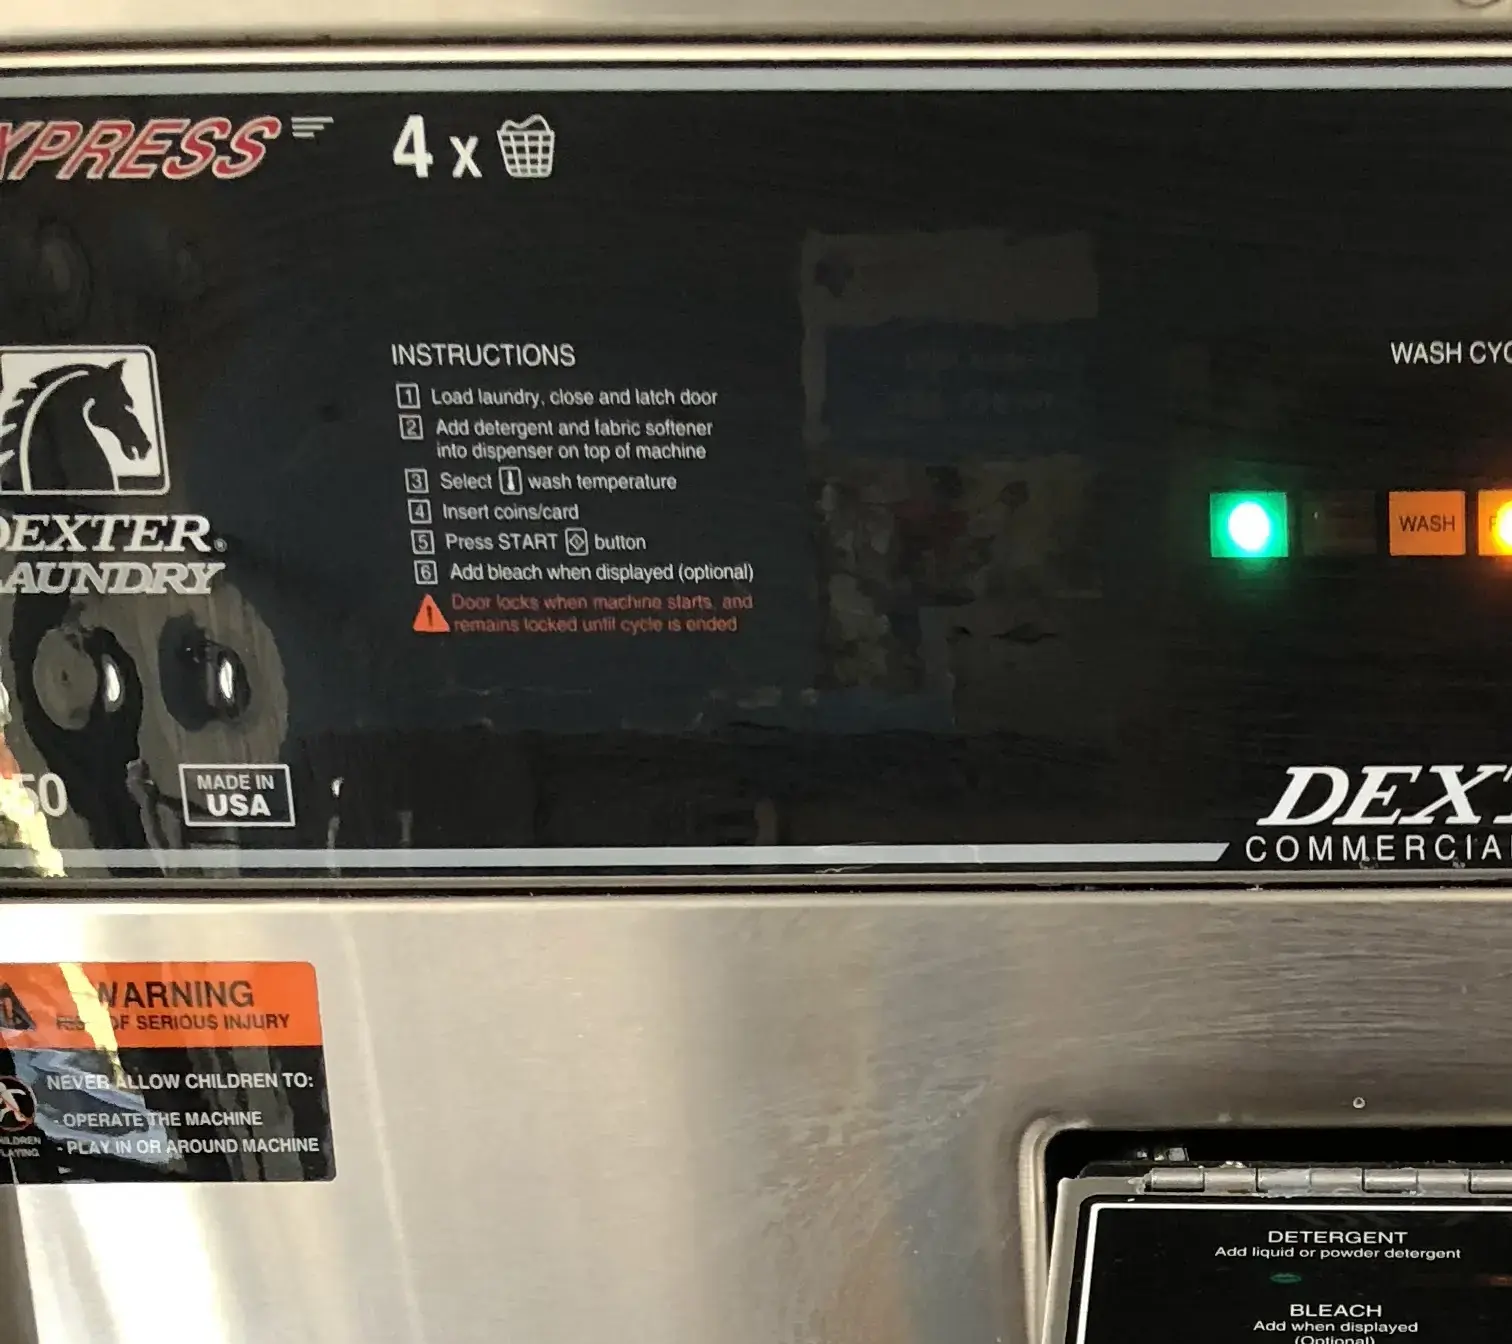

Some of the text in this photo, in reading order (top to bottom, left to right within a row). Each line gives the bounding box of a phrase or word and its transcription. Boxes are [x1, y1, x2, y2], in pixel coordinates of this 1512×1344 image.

[392, 114, 432, 179] 4
[392, 343, 576, 367] INSTRUCTIONS
[1391, 342, 1462, 365] WASH
[431, 388, 718, 409] Load laundry, close and latch door
[436, 420, 712, 439] Add detergent and fabric softener
[437, 443, 706, 463] into dispenser on top of machine
[440, 474, 677, 492] Select wash temperature
[443, 504, 579, 521] Insert coins/card
[1400, 516, 1455, 532] WASH
[446, 534, 646, 550] Press START button
[450, 563, 754, 584] Add bleach when displayed (optional)
[452, 594, 753, 610] Door locks when machine and
[198, 774, 275, 791] MADE IN
[207, 794, 270, 818] USA
[114, 1014, 290, 1030] OF SERIOUS INJURY
[47, 1073, 314, 1090] NEVER ALLOW CHILDREN TO:
[63, 1111, 263, 1127] OPERATE THE MACHINE
[67, 1137, 319, 1154] PLAY IN OR AROUND MACHINE
[1268, 1231, 1407, 1243] DETERGENT
[1215, 1246, 1461, 1260] Add liquid or powder detergent
[1290, 1304, 1381, 1317] BLEACH
[1254, 1321, 1418, 1335] Add when displayed
